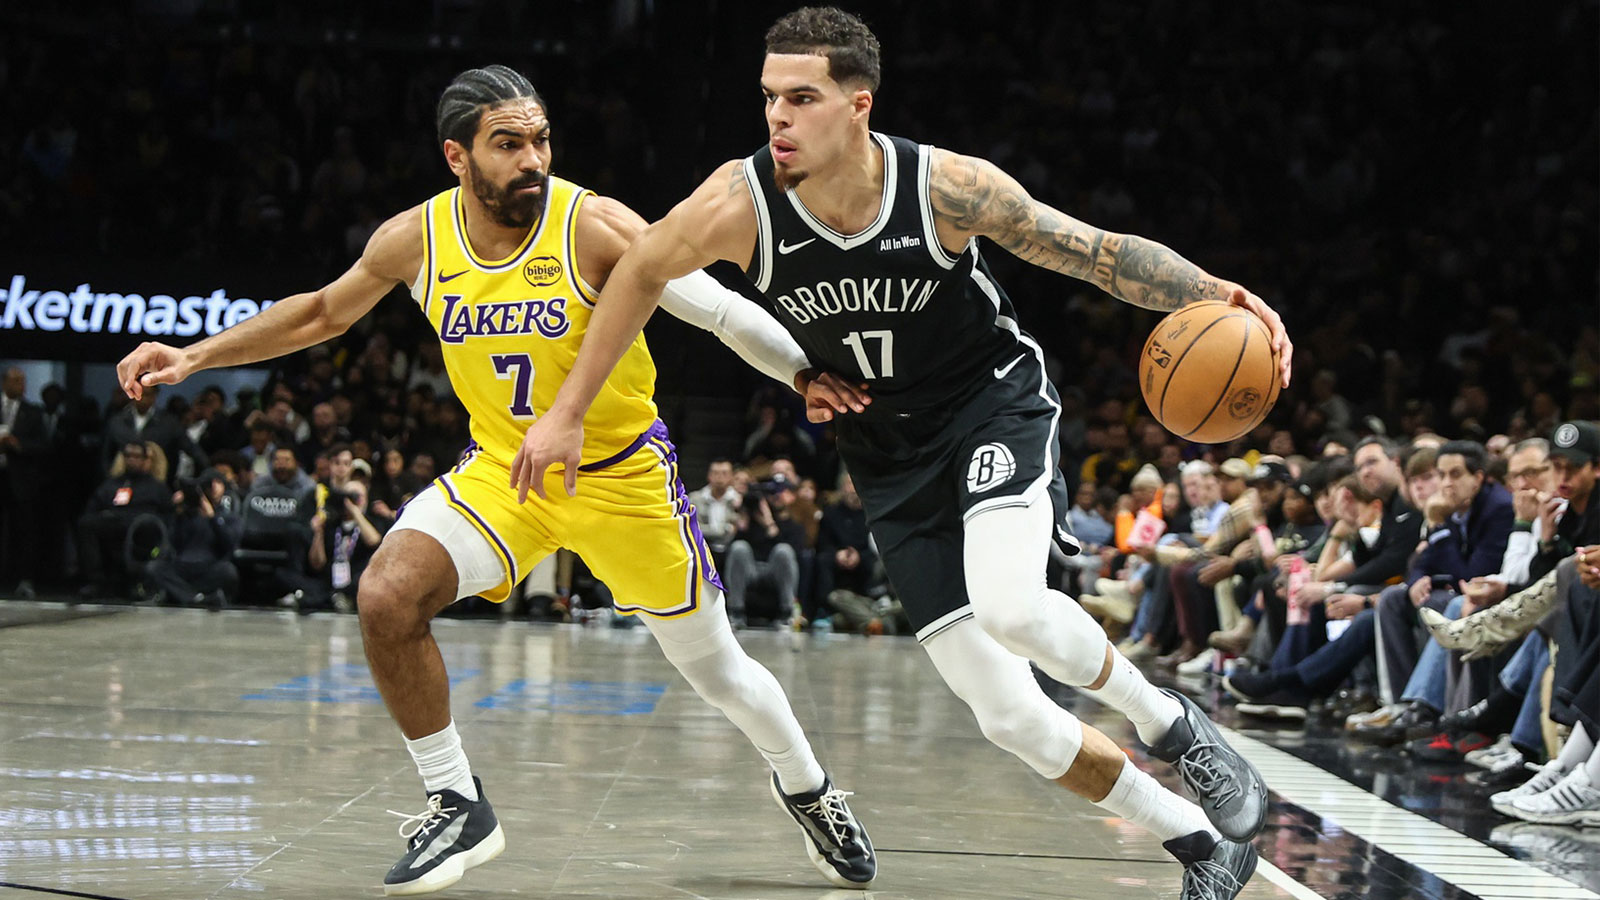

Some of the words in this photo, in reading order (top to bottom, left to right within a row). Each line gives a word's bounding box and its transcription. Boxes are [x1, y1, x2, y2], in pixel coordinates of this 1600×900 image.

[880, 239, 892, 251] All
[892, 238, 902, 250] In
[900, 235, 921, 248] Won
[527, 264, 561, 278] bibigo
[0, 274, 274, 337] ketmaste
[439, 294, 573, 345] LAKERS
[777, 278, 941, 325] BROOKLYN
[841, 329, 894, 380] 17
[489, 353, 537, 421] 7
[976, 450, 995, 487] B
